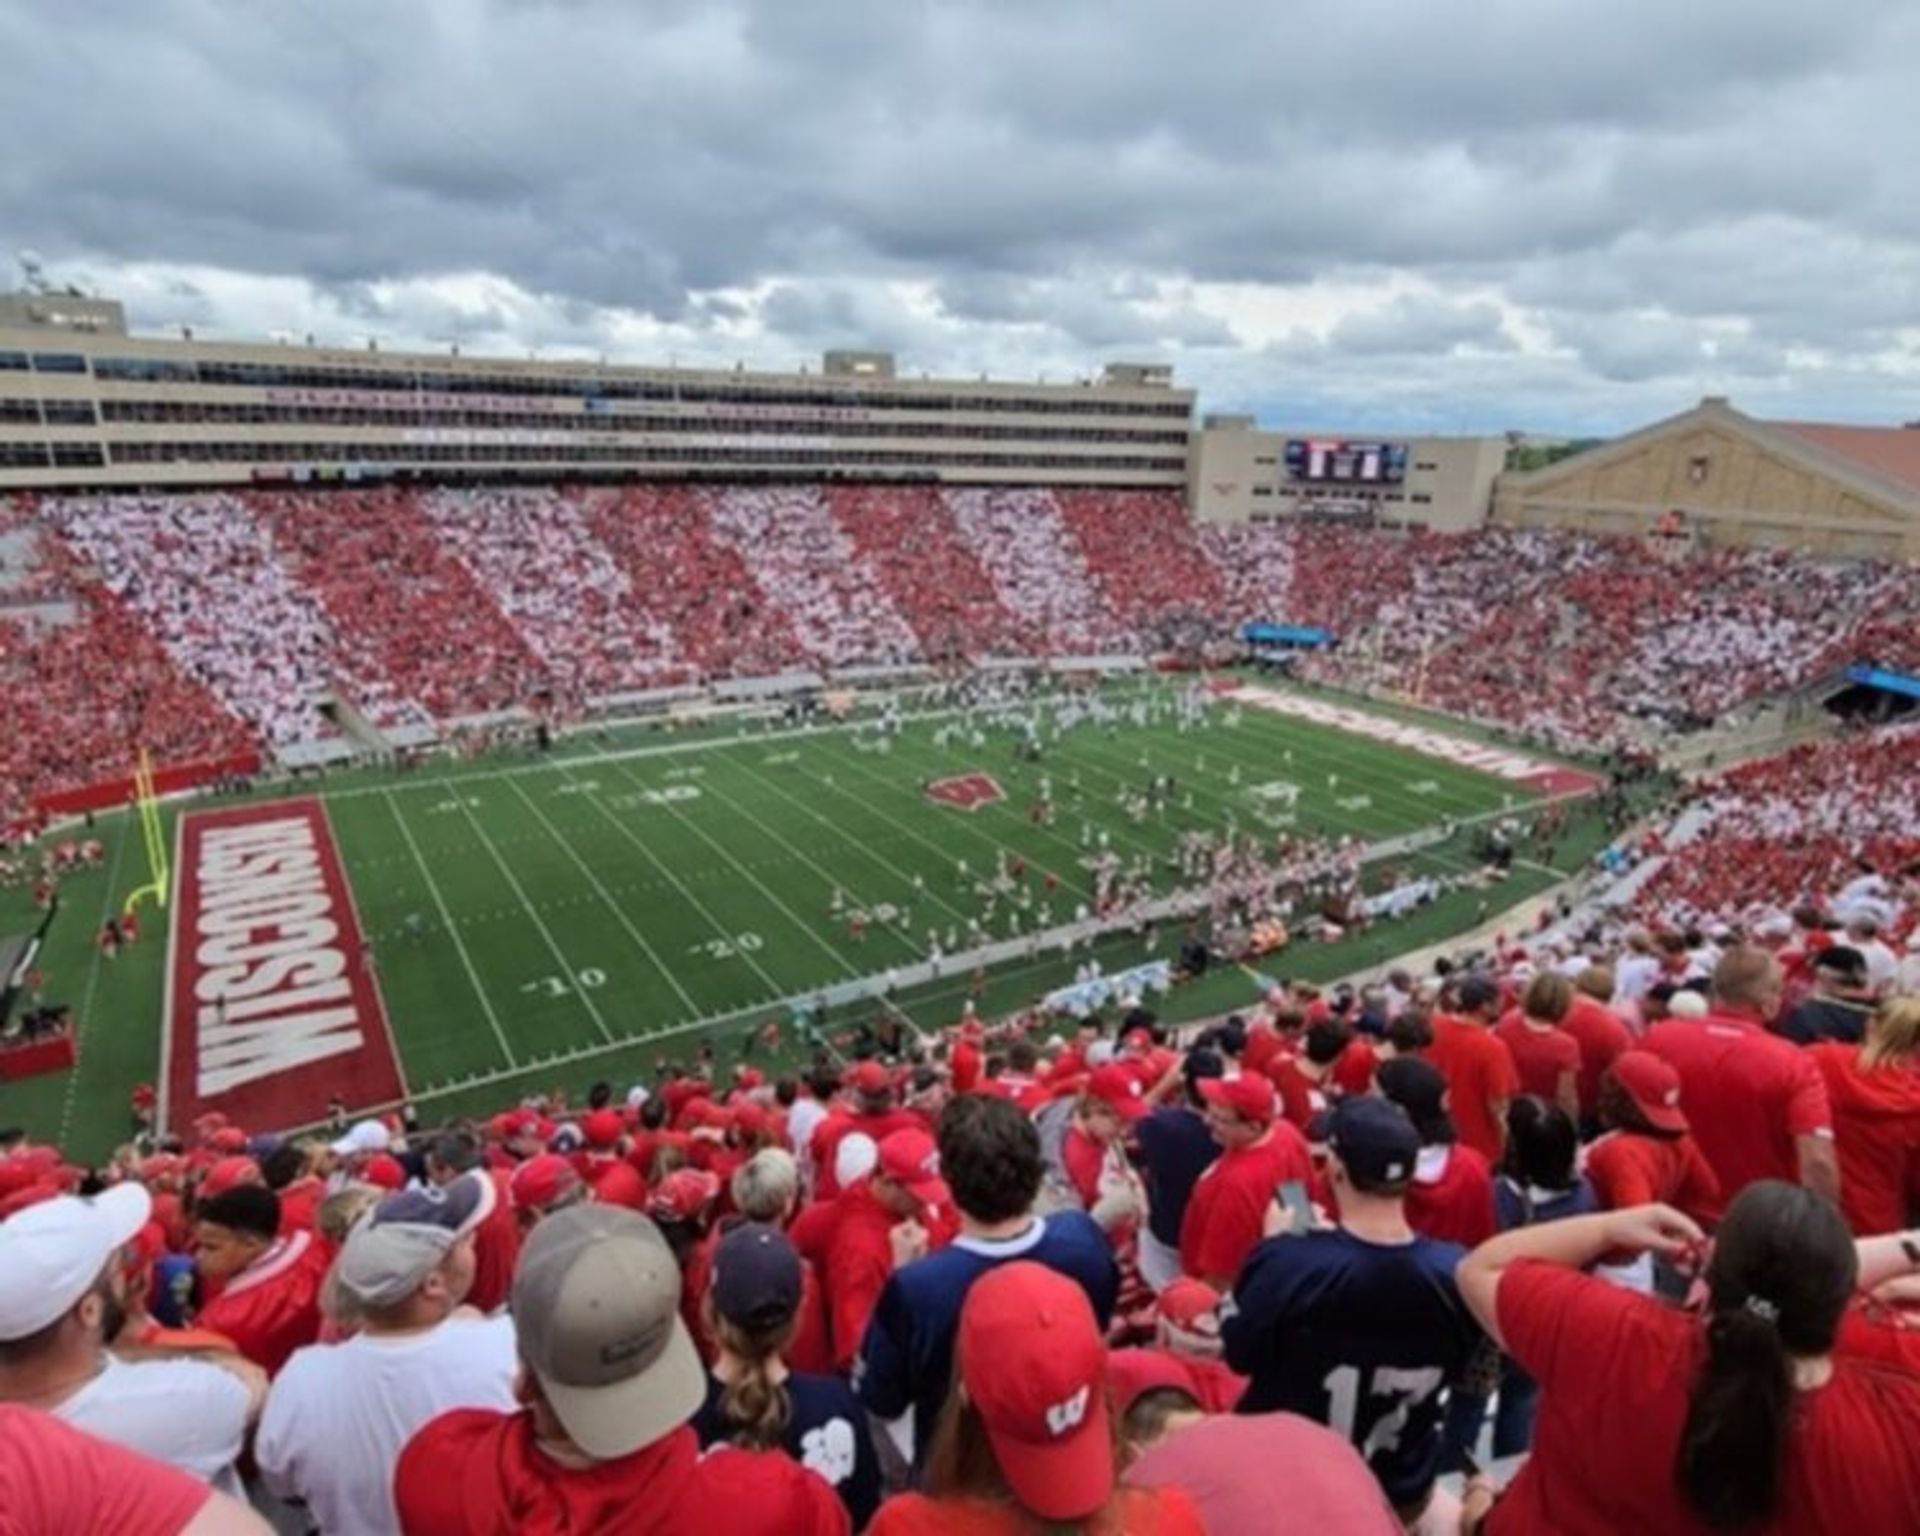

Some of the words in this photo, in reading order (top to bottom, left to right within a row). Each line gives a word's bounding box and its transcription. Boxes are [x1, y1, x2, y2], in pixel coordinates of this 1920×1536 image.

[195, 816, 365, 1097] WISCONSIN
[705, 931, 763, 958] 20
[540, 967, 606, 998] 10
[1046, 1385, 1090, 1434] W
[1322, 1364, 1444, 1461] 17
